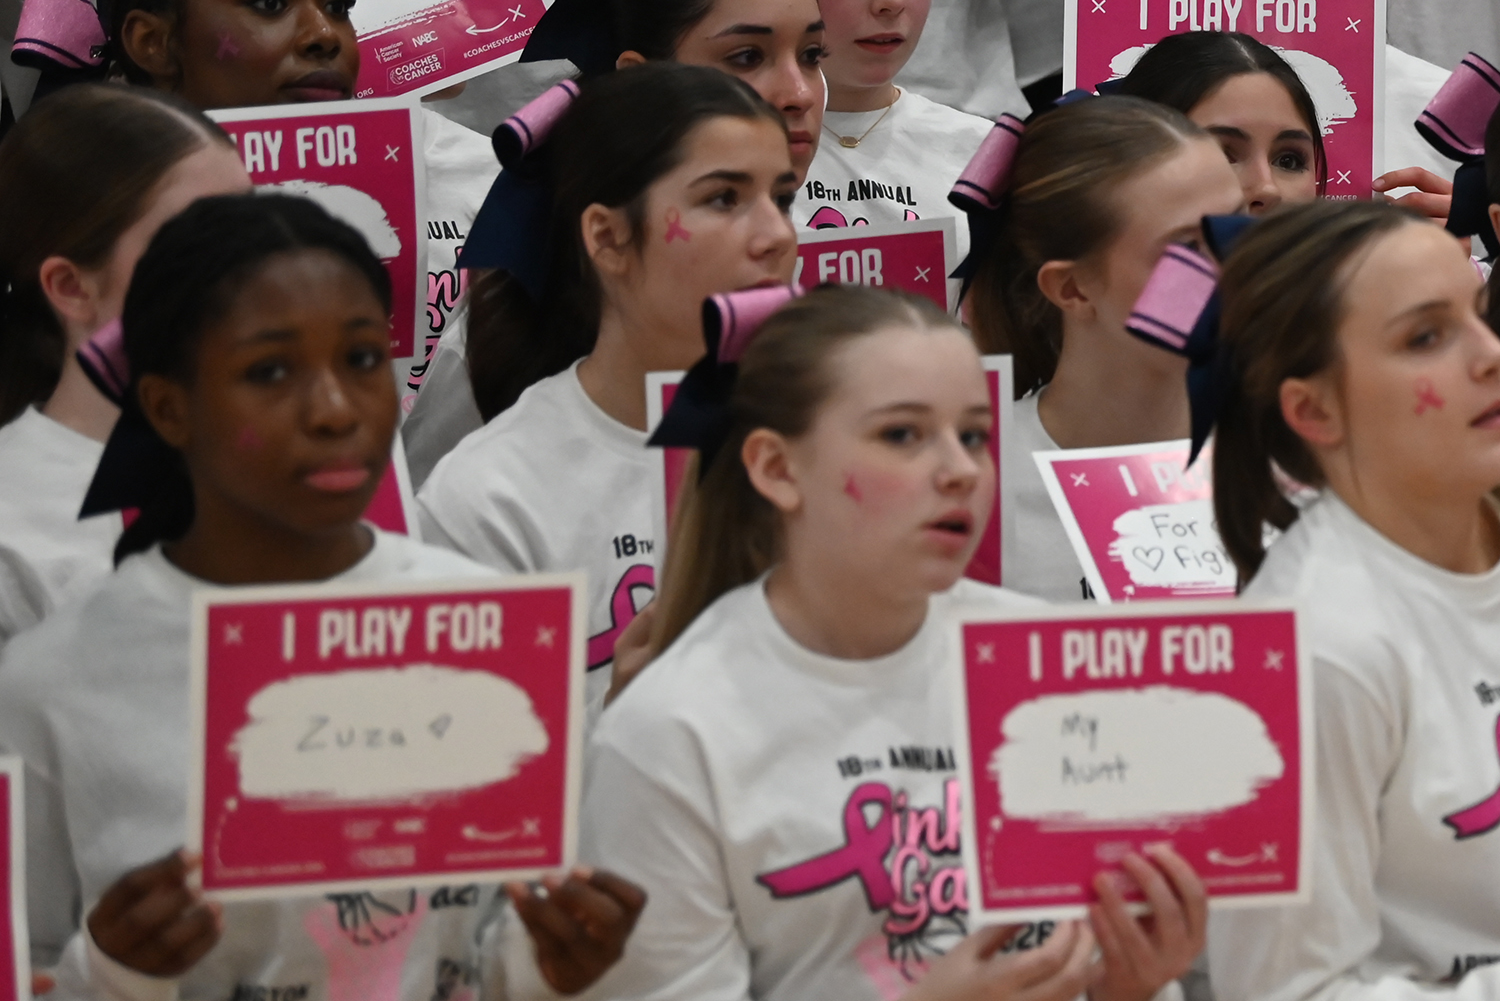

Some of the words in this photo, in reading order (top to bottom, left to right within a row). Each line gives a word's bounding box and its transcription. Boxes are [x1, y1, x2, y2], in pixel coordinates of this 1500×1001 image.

[412, 30, 439, 48] NABC
[394, 54, 439, 76] COACHES
[404, 61, 442, 82] CANCER
[296, 124, 358, 169] FOR
[805, 180, 842, 203] 18TH
[846, 179, 918, 207] ANNUAL
[818, 248, 884, 287] FOR
[1118, 463, 1139, 497] I
[1149, 512, 1199, 539] For
[283, 612, 295, 661] I
[318, 607, 412, 658] PLAY
[426, 603, 502, 653] FOR
[1030, 632, 1042, 681] I
[1062, 629, 1149, 679] PLAY
[1161, 625, 1234, 674] FOR
[297, 716, 409, 754] Zuza
[1060, 713, 1101, 750] My
[1060, 757, 1130, 786] Aunt
